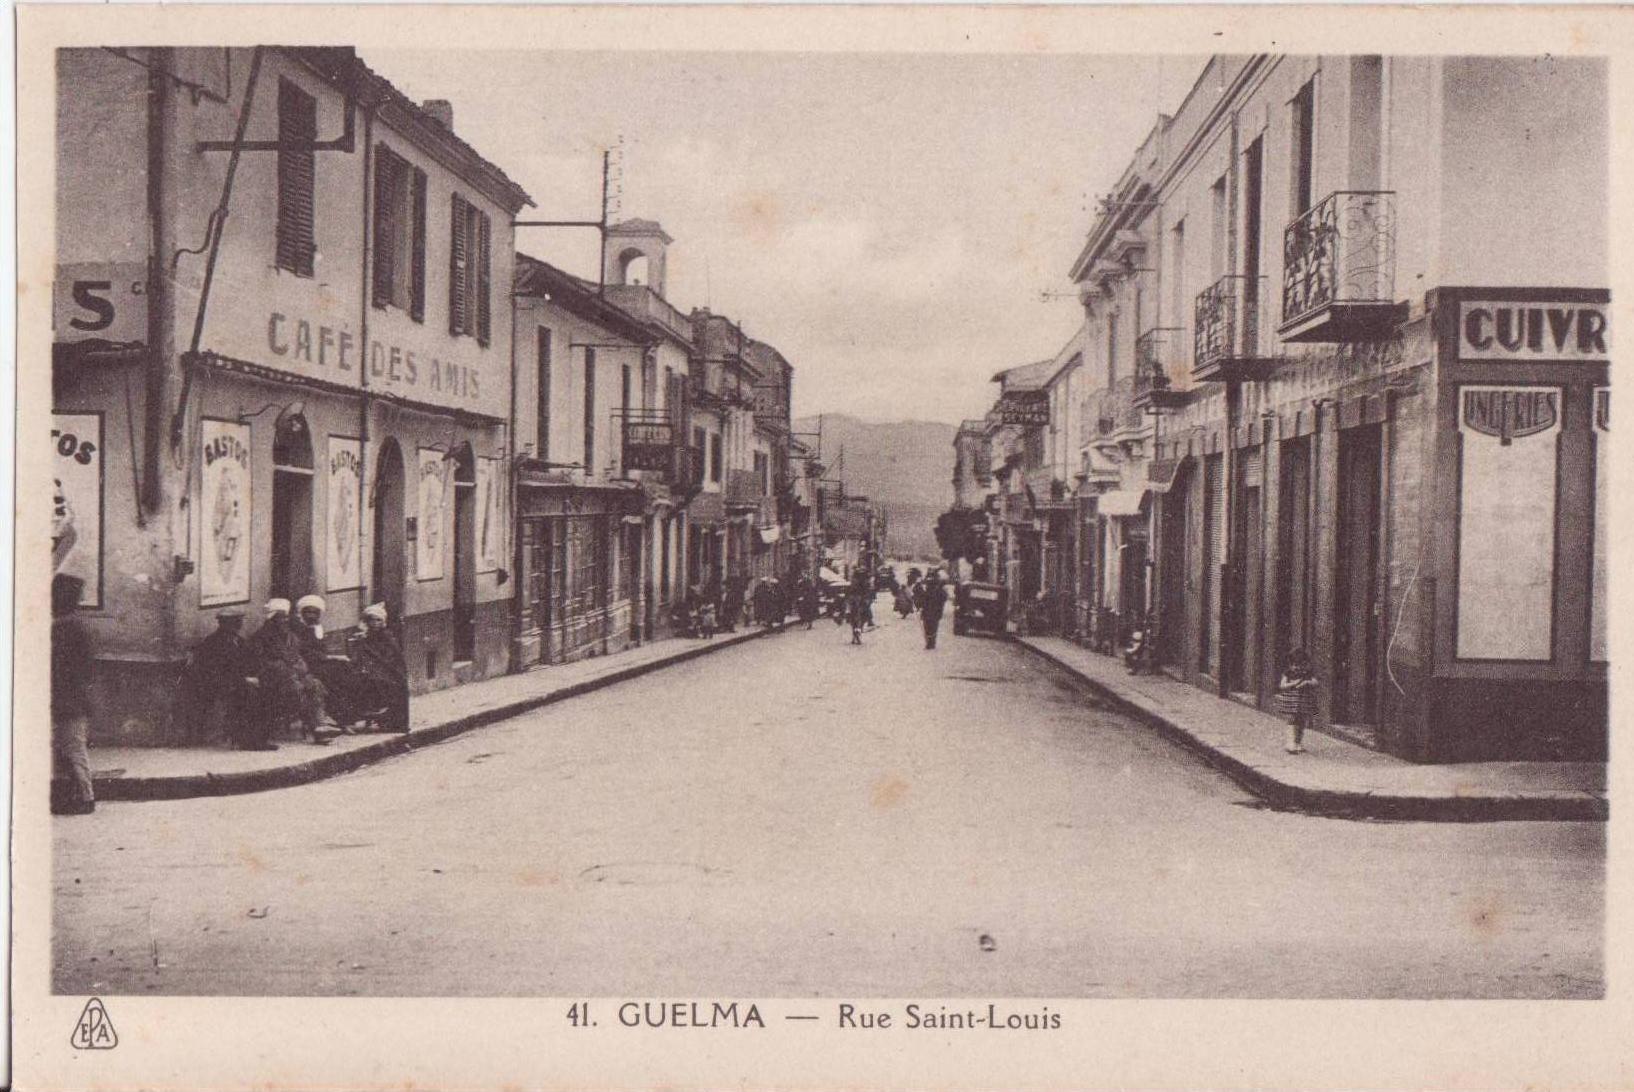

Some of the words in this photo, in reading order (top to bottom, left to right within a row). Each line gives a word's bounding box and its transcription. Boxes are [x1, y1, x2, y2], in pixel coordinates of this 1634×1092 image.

[1465, 308, 1607, 354] CUIVR
[268, 312, 353, 371] CAFÉ
[371, 340, 417, 386] DES
[430, 358, 480, 399] AMIS
[204, 435, 248, 470] BASTOS
